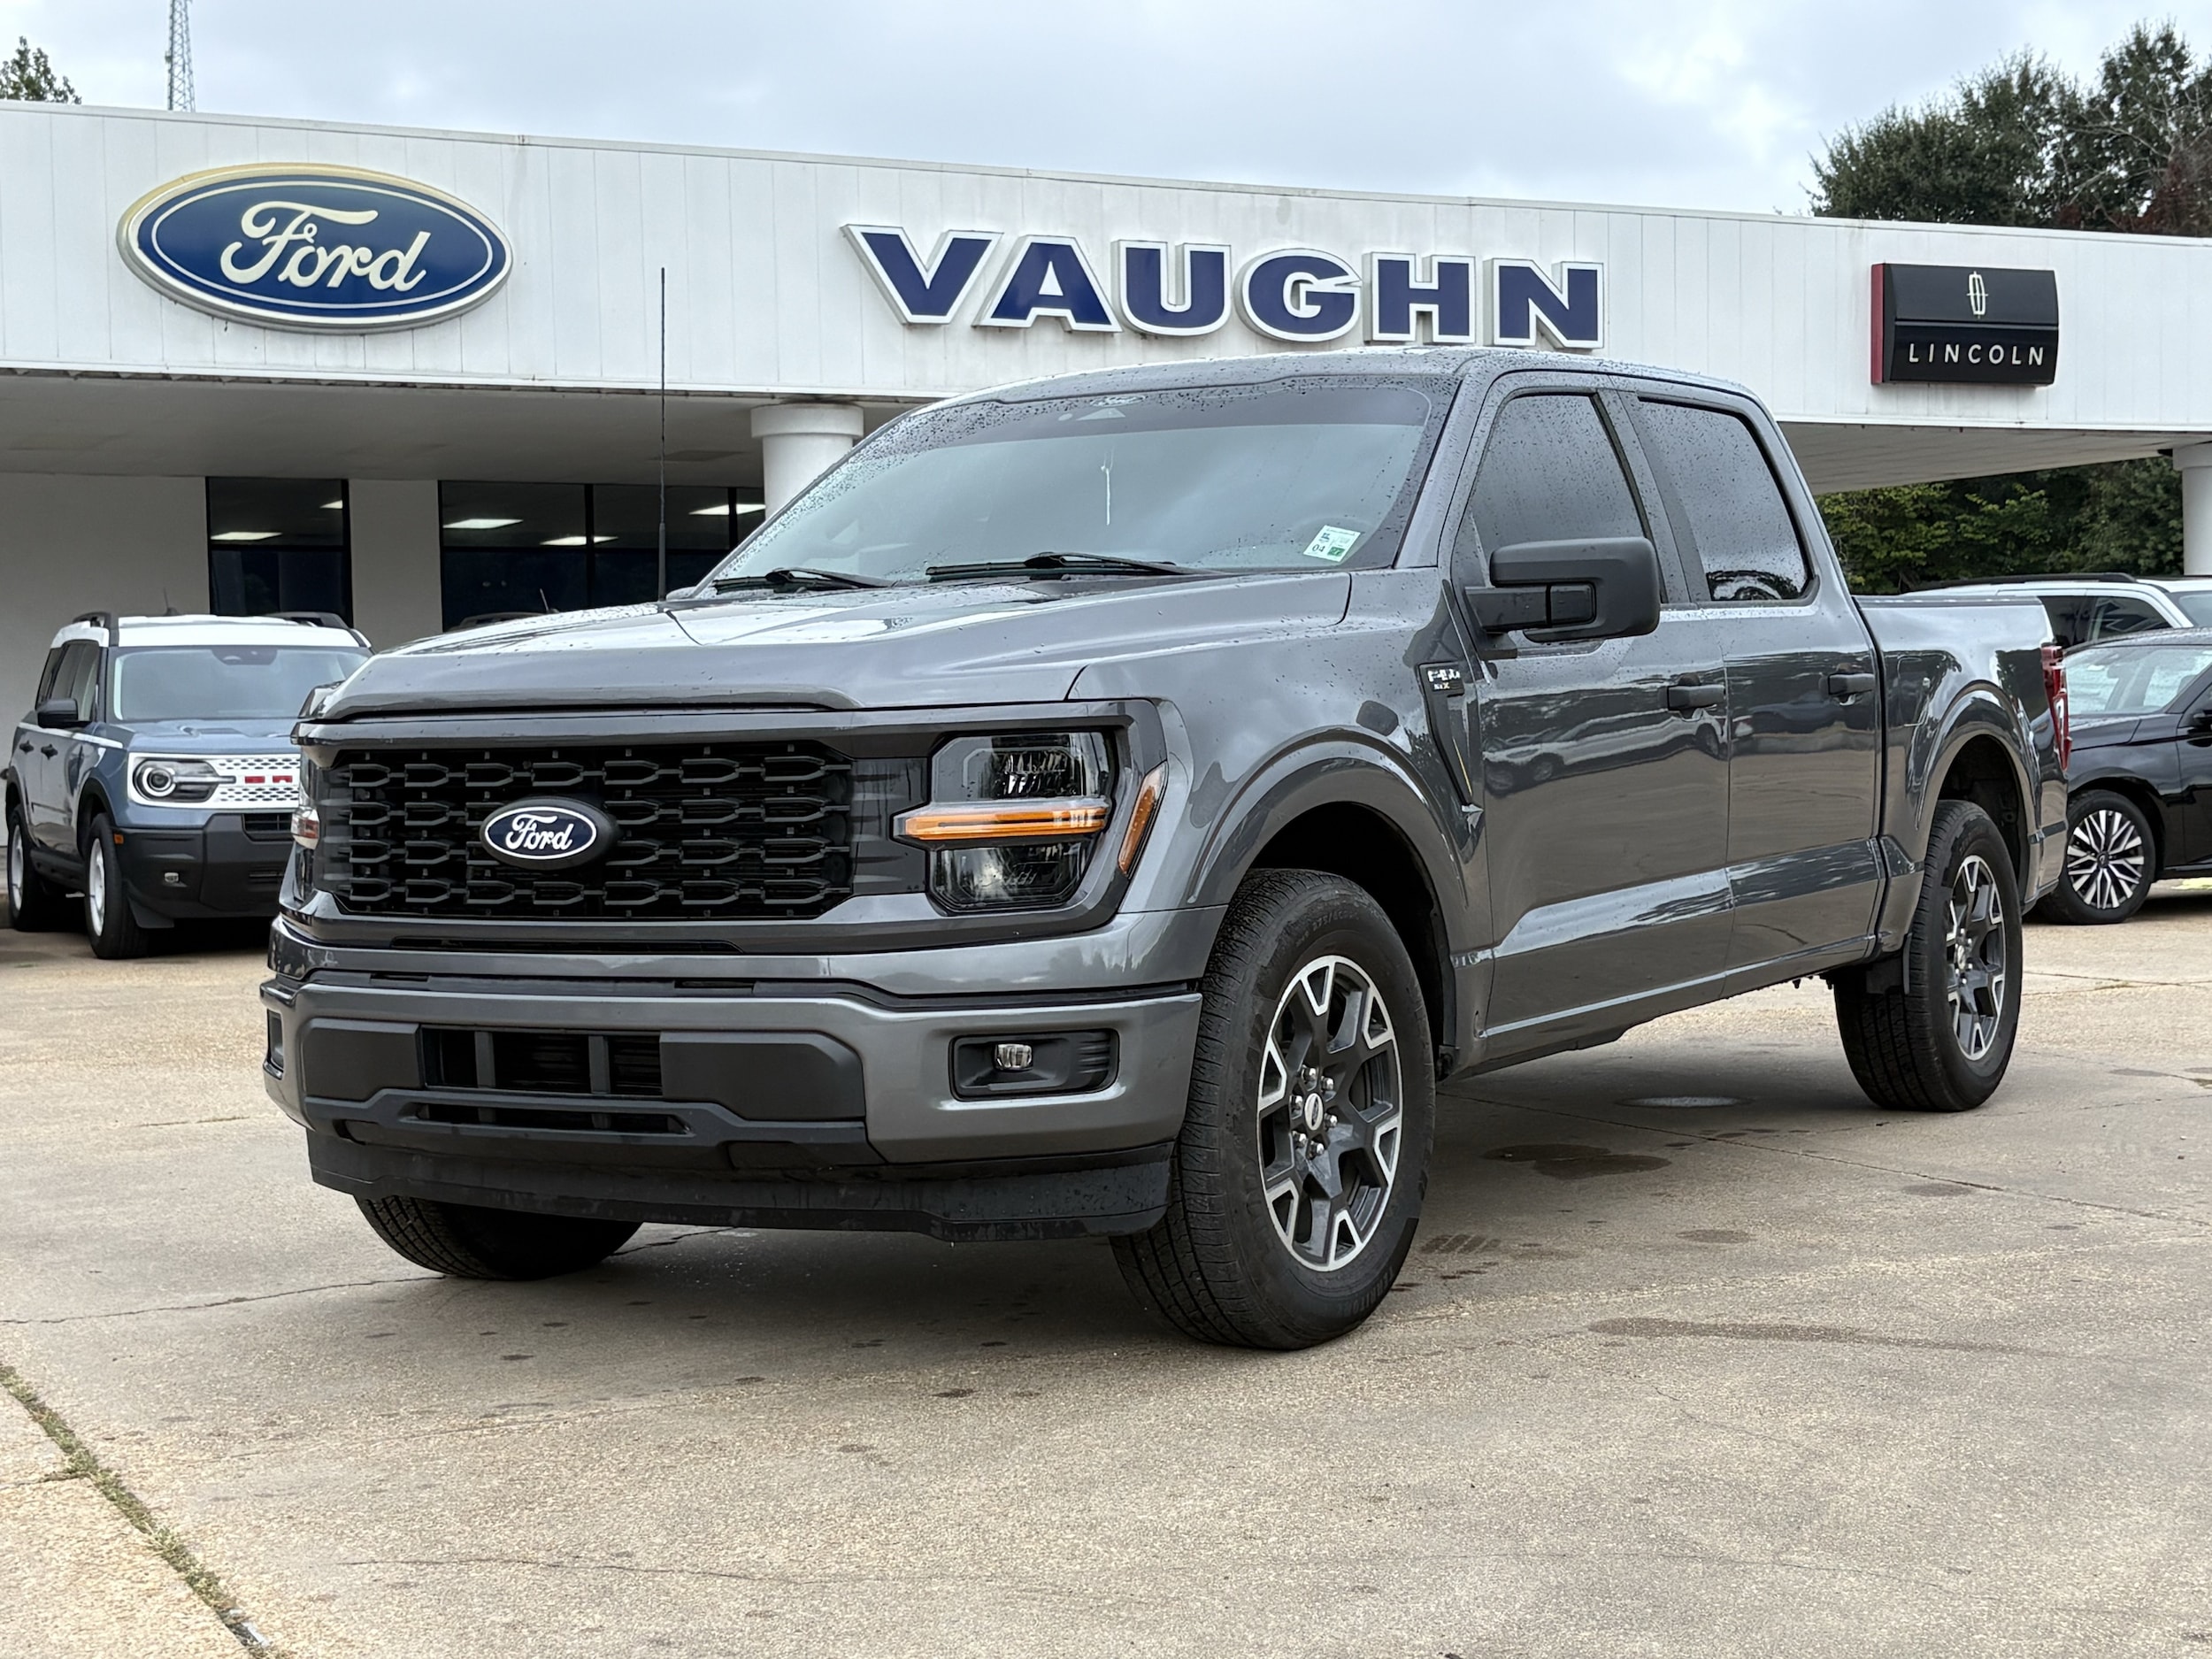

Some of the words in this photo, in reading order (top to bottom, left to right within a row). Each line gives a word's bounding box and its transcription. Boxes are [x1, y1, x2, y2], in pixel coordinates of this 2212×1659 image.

[220, 201, 432, 292] Ford
[841, 223, 1604, 349] VAUGHN
[1909, 342, 2044, 366] LINCOLN
[504, 813, 574, 850] Ford
